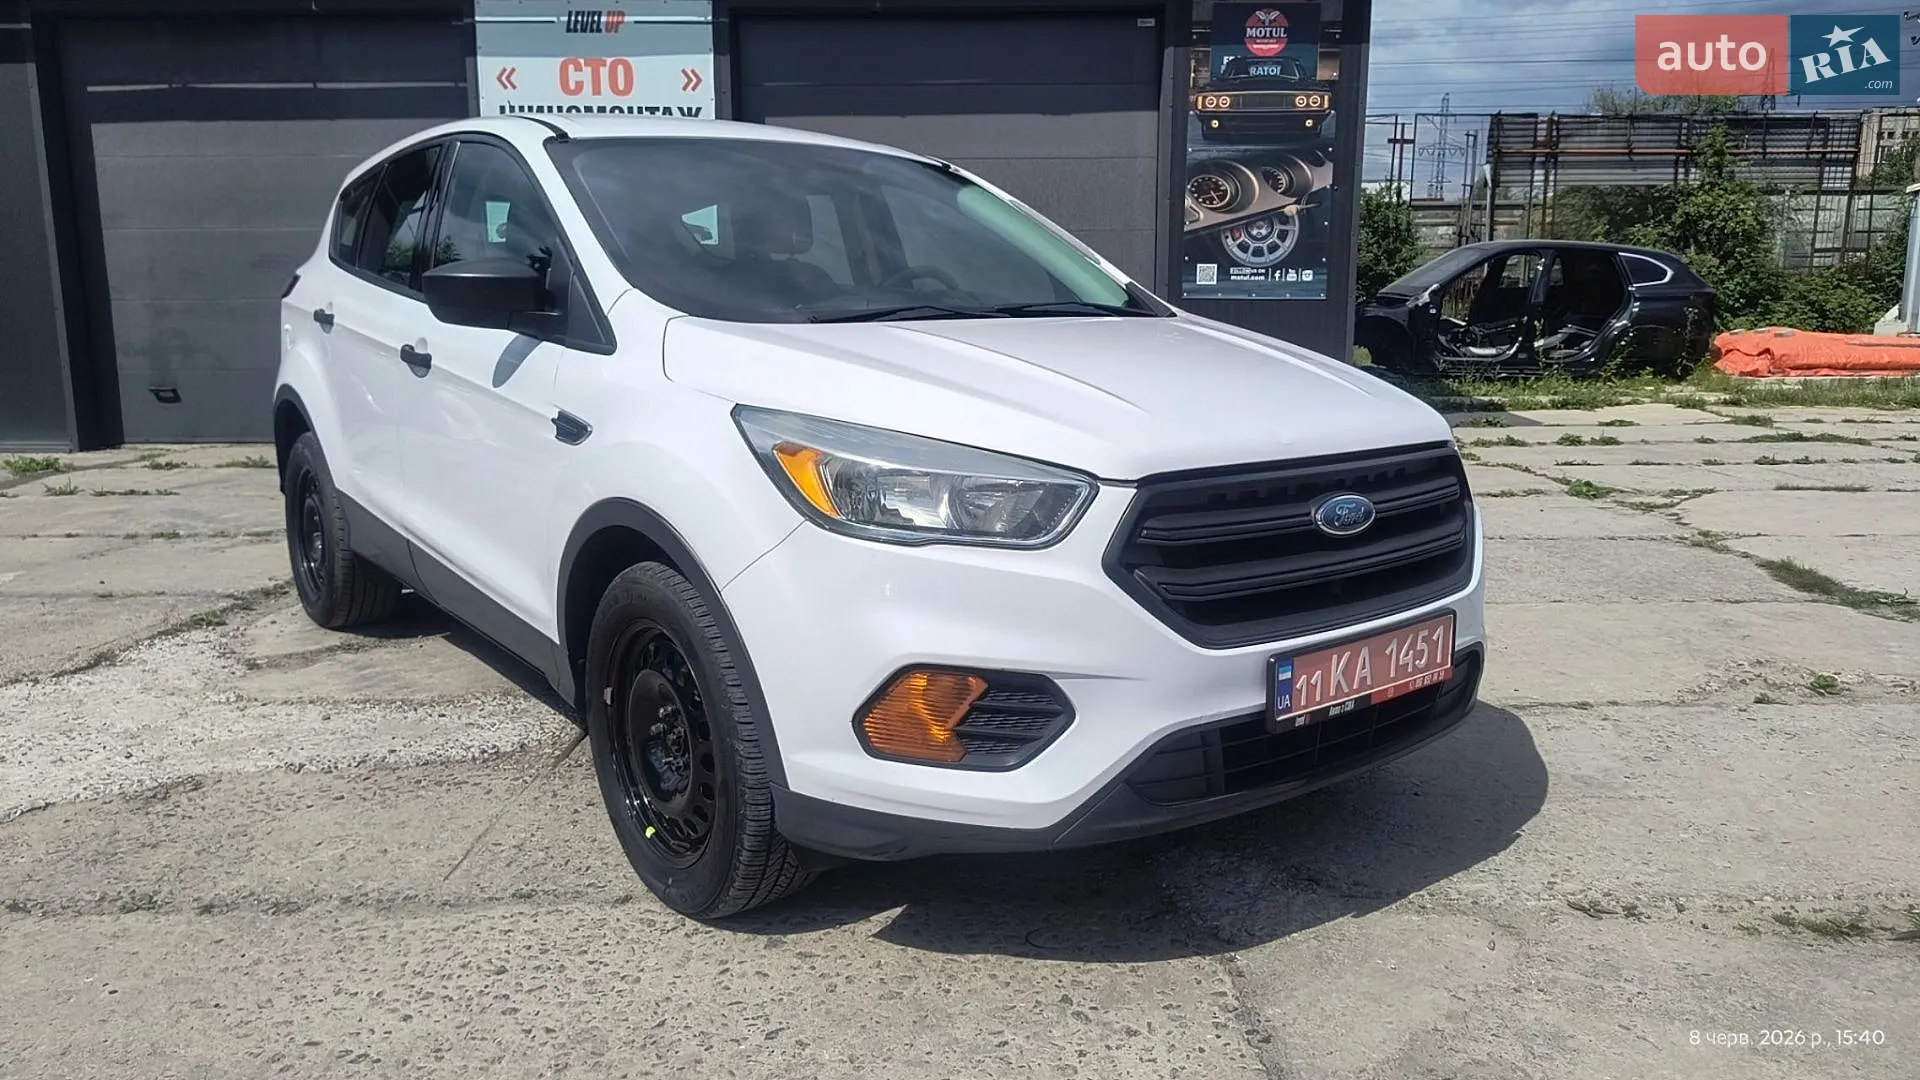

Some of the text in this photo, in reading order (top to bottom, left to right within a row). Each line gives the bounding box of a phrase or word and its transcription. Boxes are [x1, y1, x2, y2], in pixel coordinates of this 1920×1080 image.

[565, 10, 626, 34] LEVEL UP
[1246, 27, 1287, 38] MOTUL
[559, 56, 635, 97] СТО
[1334, 502, 1364, 526] Ford
[1295, 624, 1444, 706] 11 KA 1451
[1277, 693, 1291, 710] UA
